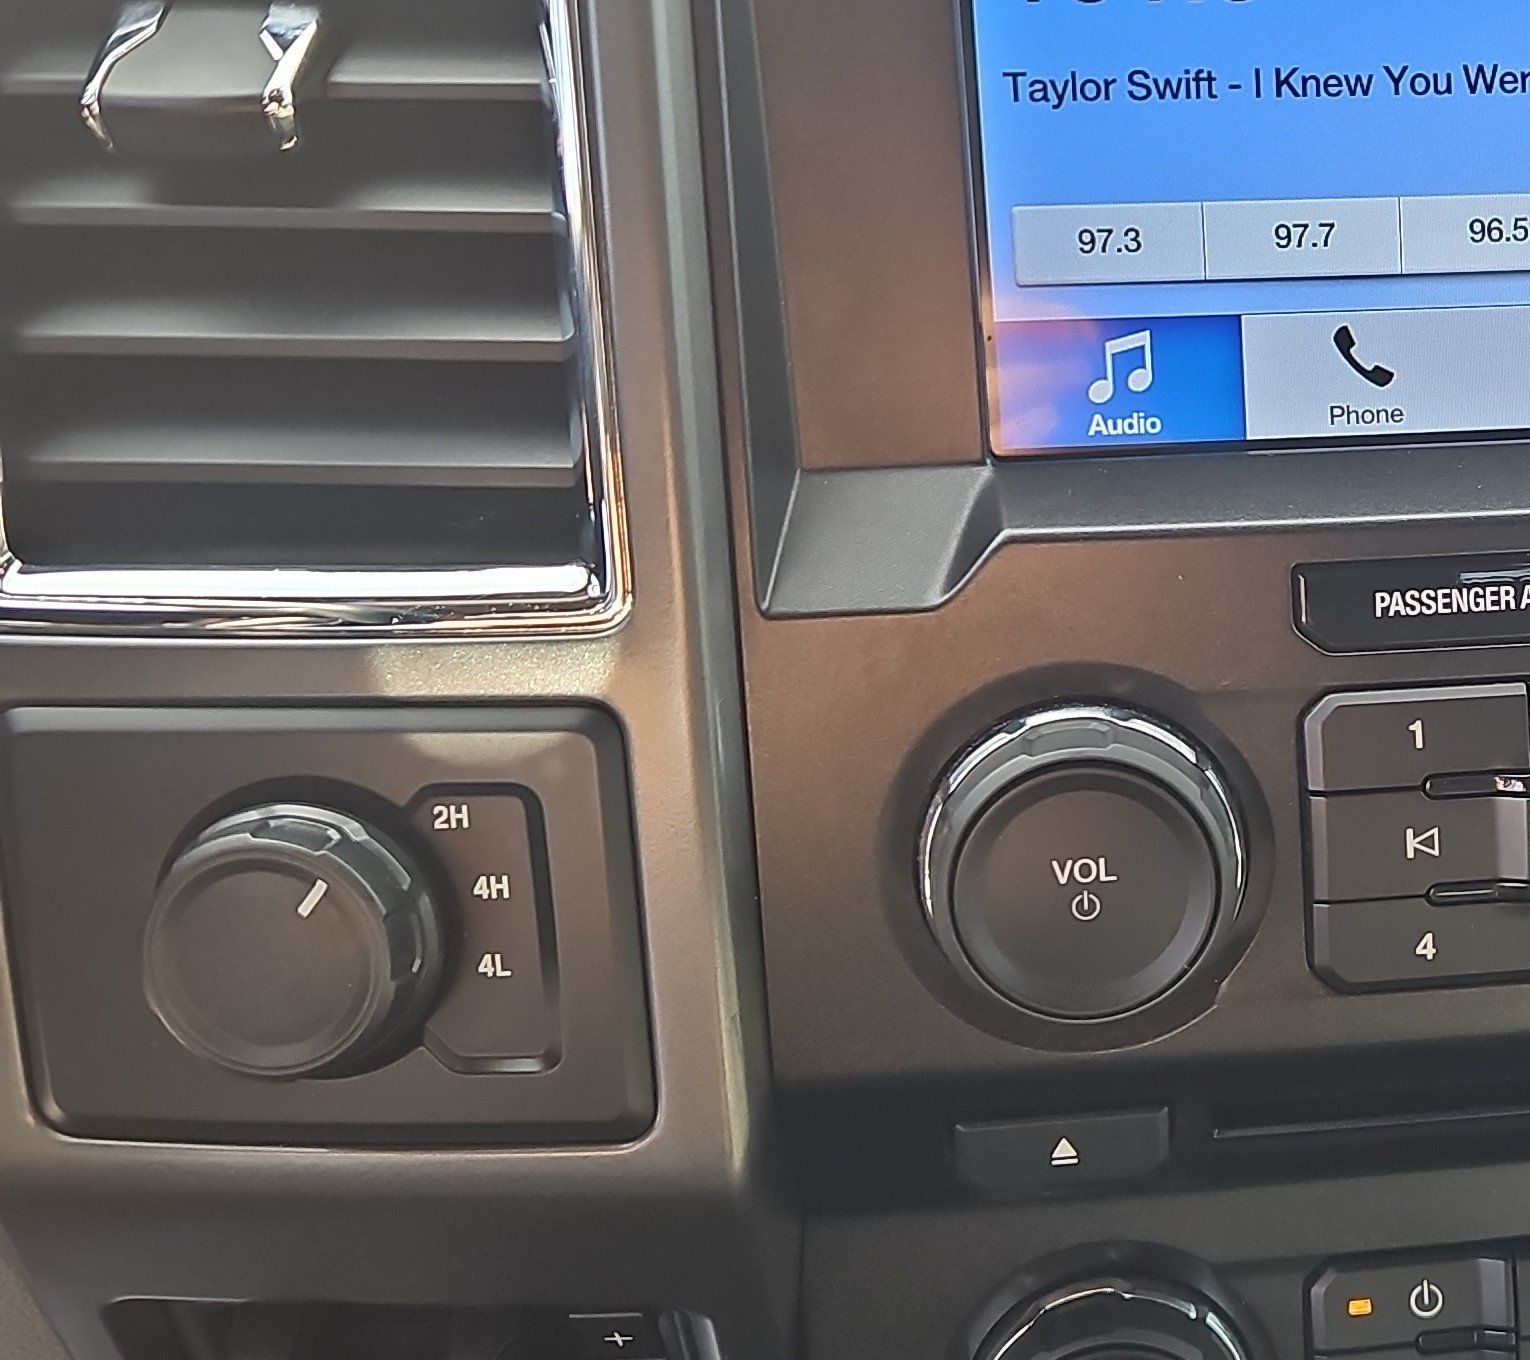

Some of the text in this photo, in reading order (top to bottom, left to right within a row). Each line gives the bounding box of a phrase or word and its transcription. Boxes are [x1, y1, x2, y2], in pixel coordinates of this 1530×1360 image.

[1004, 71, 1116, 109] Taylor
[1127, 68, 1217, 102] Swift
[1254, 68, 1262, 99] I
[1274, 67, 1373, 99] Knew
[1384, 66, 1454, 96] You
[1077, 228, 1142, 254] 97.3
[1274, 222, 1336, 249] 97.7
[1468, 217, 1529, 244] 96.5
[1088, 413, 1162, 436] Audio
[1329, 404, 1404, 426] Phone
[1374, 585, 1516, 617] PASSENGER
[1408, 720, 1425, 749] 1
[432, 805, 469, 829] 2H
[1052, 858, 1118, 884] VOL
[473, 875, 510, 900] 4H
[1415, 932, 1436, 960] 4
[478, 954, 511, 978] 4L
